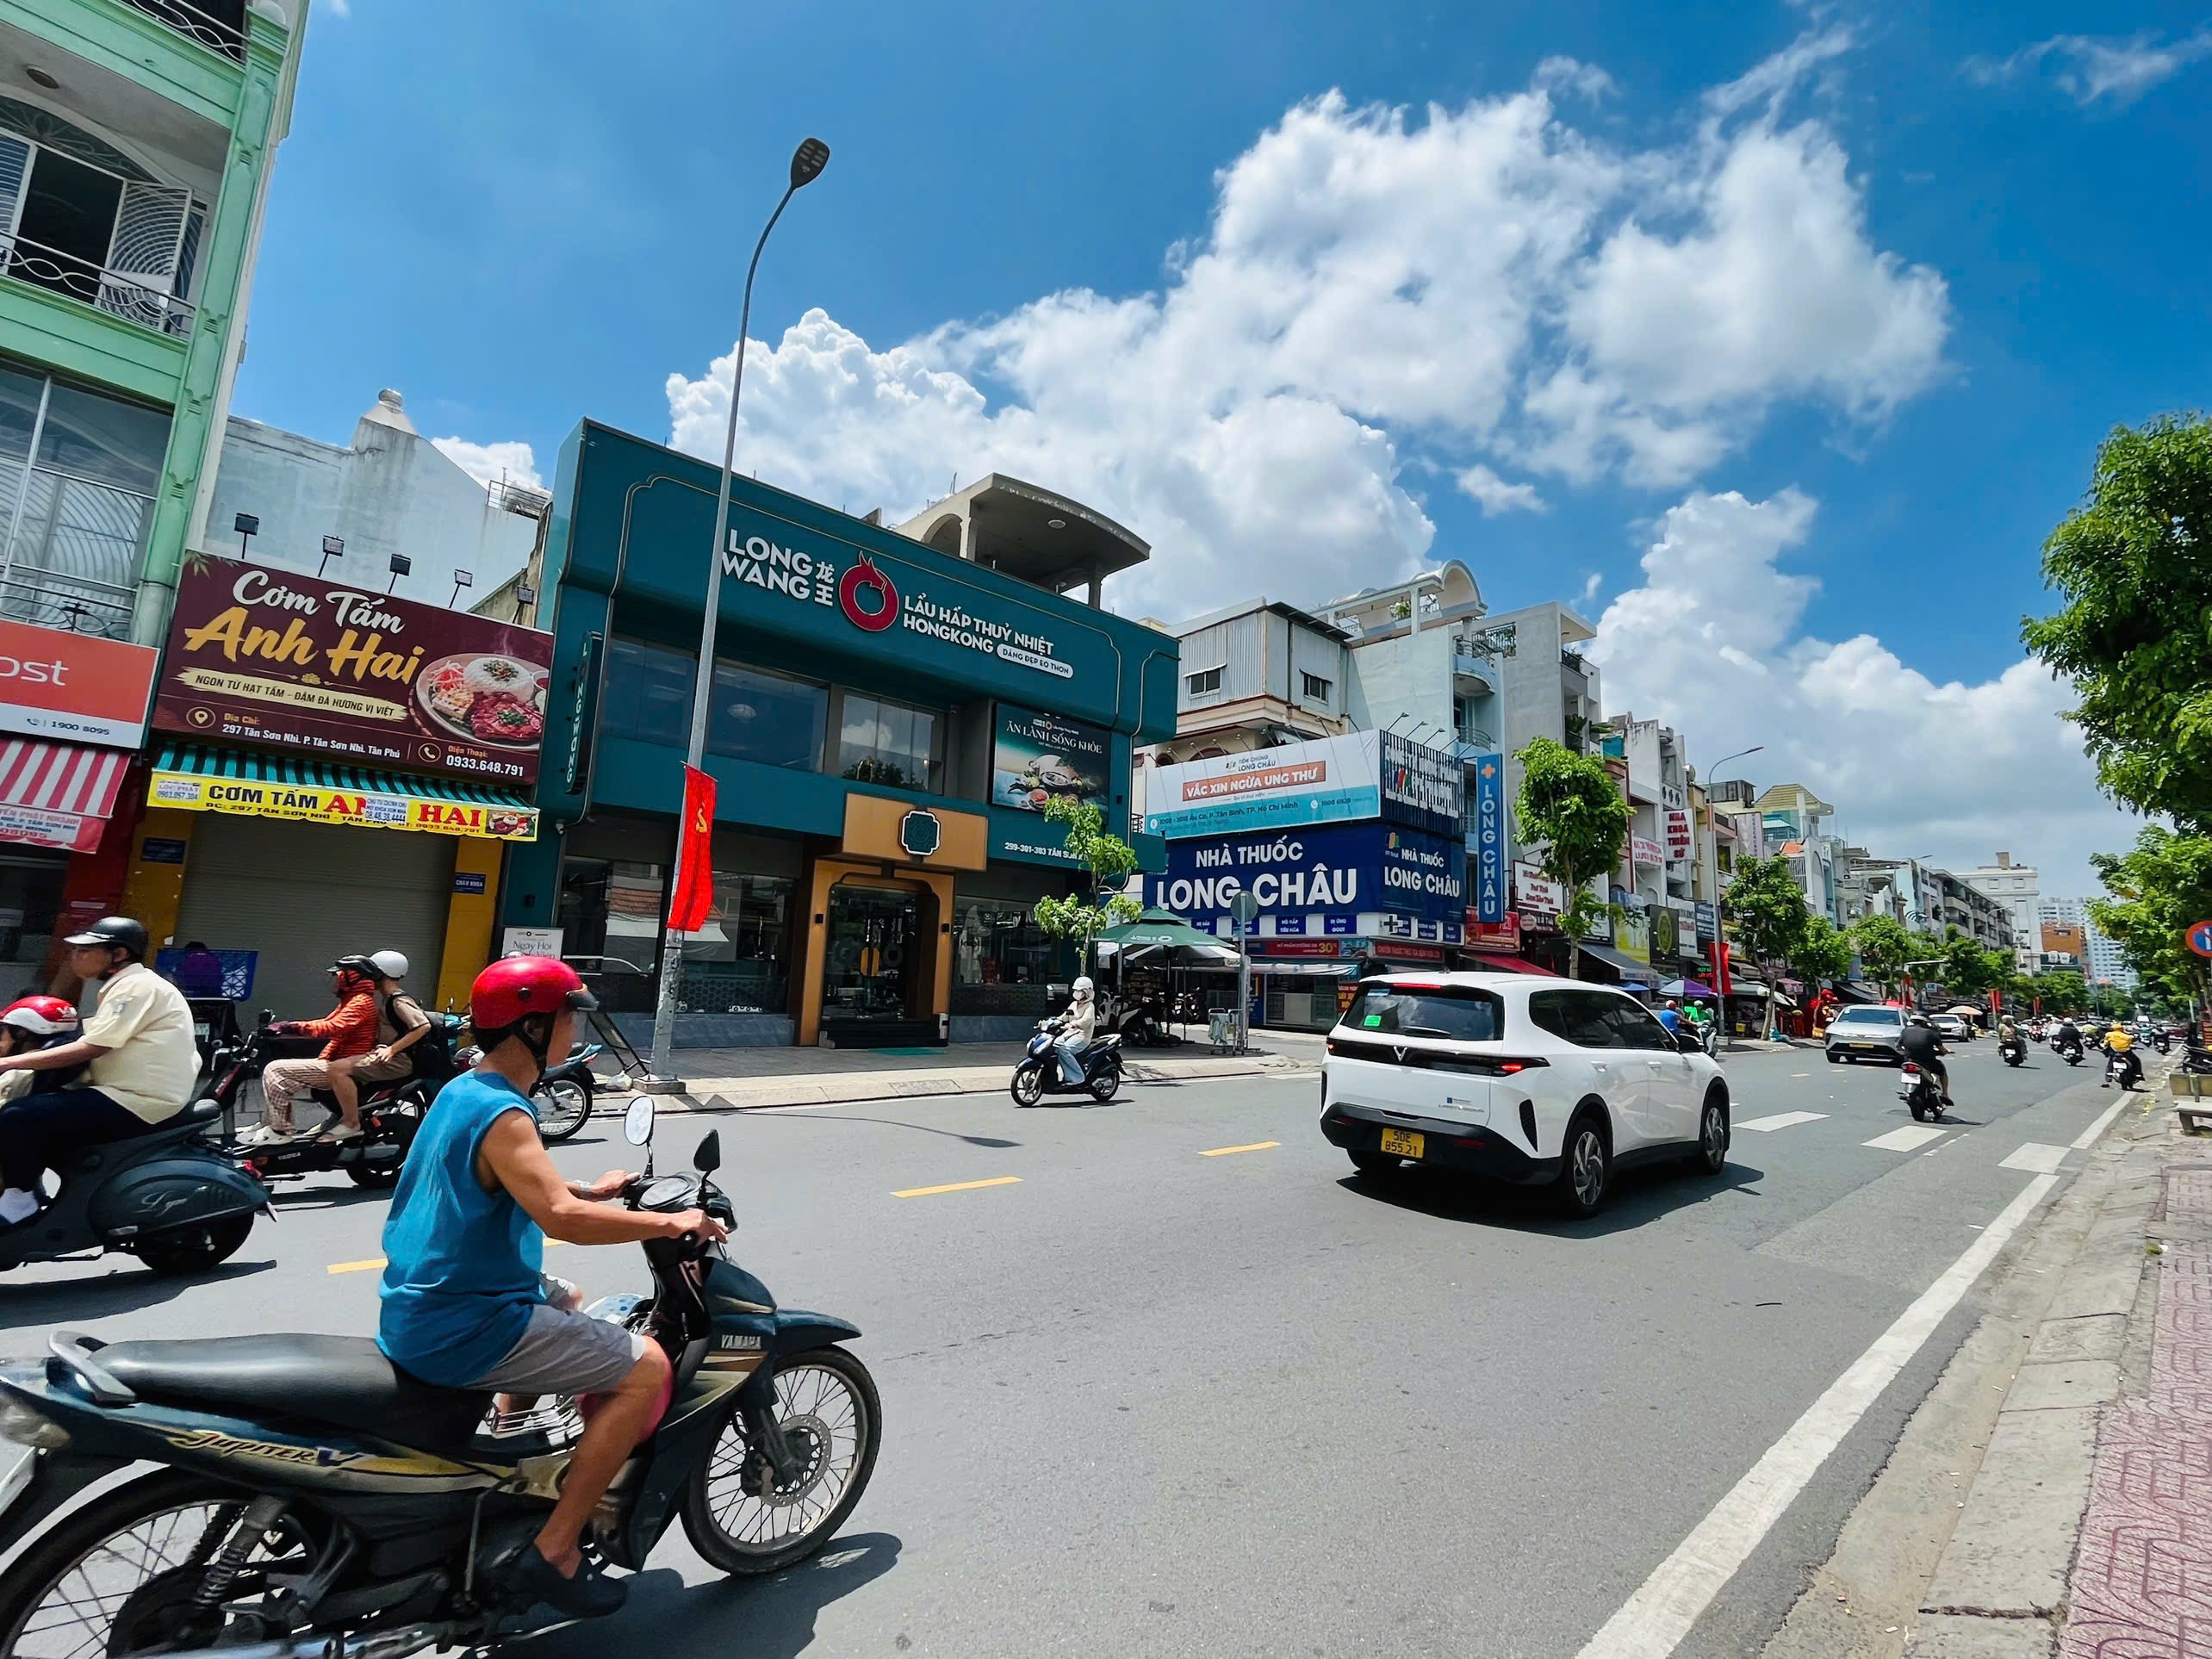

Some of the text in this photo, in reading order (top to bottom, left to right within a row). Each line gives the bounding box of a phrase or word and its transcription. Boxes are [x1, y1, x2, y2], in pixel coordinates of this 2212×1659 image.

[729, 529, 813, 576] LONG
[722, 551, 811, 600] WANG
[233, 570, 406, 635] Cơm Tấm
[903, 613, 995, 654] HONGKONG
[904, 593, 1054, 656] LẨU HẤP THUỶ NHIỆT
[183, 606, 426, 685] Anh Hai
[1003, 648, 1023, 662] DÁNG
[1039, 659, 1049, 668] EO
[1050, 662, 1069, 674] THON
[195, 674, 224, 687] NGON
[243, 681, 262, 695] HẠT
[264, 684, 285, 698] TẤM
[317, 694, 331, 705] ĐÀ
[332, 698, 363, 712] HƯƠNG
[365, 704, 374, 715] VỊ
[376, 705, 395, 717] VIỆT
[52, 720, 110, 736] 1900 8095
[221, 724, 242, 735] 297
[244, 727, 260, 738] Tân
[262, 730, 281, 742] Sơn
[303, 736, 311, 745] P.
[313, 737, 328, 749] Tân
[330, 740, 347, 751] Sơn
[368, 746, 382, 756] Tân
[383, 748, 401, 759] Phú
[1006, 720, 1021, 734] ĂN
[1022, 725, 1049, 742] LÀNH
[1052, 732, 1077, 748] SỐNG
[446, 755, 524, 777] 0933.648.791
[1209, 783, 1228, 795] XIN
[1230, 775, 1263, 791] NGỪA
[1264, 772, 1290, 786] UNG
[1291, 767, 1319, 782] THƯ
[1238, 760, 1277, 772] LONG CHÂU
[208, 785, 263, 804] CƠM
[270, 788, 318, 809] TẤM
[418, 803, 482, 827] HAI
[257, 806, 280, 815] TÂN
[1281, 800, 1299, 810] Minh
[1047, 848, 1062, 859] TÂN
[1196, 835, 1303, 868] NHÀ THUỐC
[1401, 848, 1445, 868] NHÀ THUỐC
[1482, 784, 1496, 915] LONG CHÂU
[1157, 862, 1358, 911] LONG CHÂU
[1384, 866, 1460, 898] LONG CHÂU
